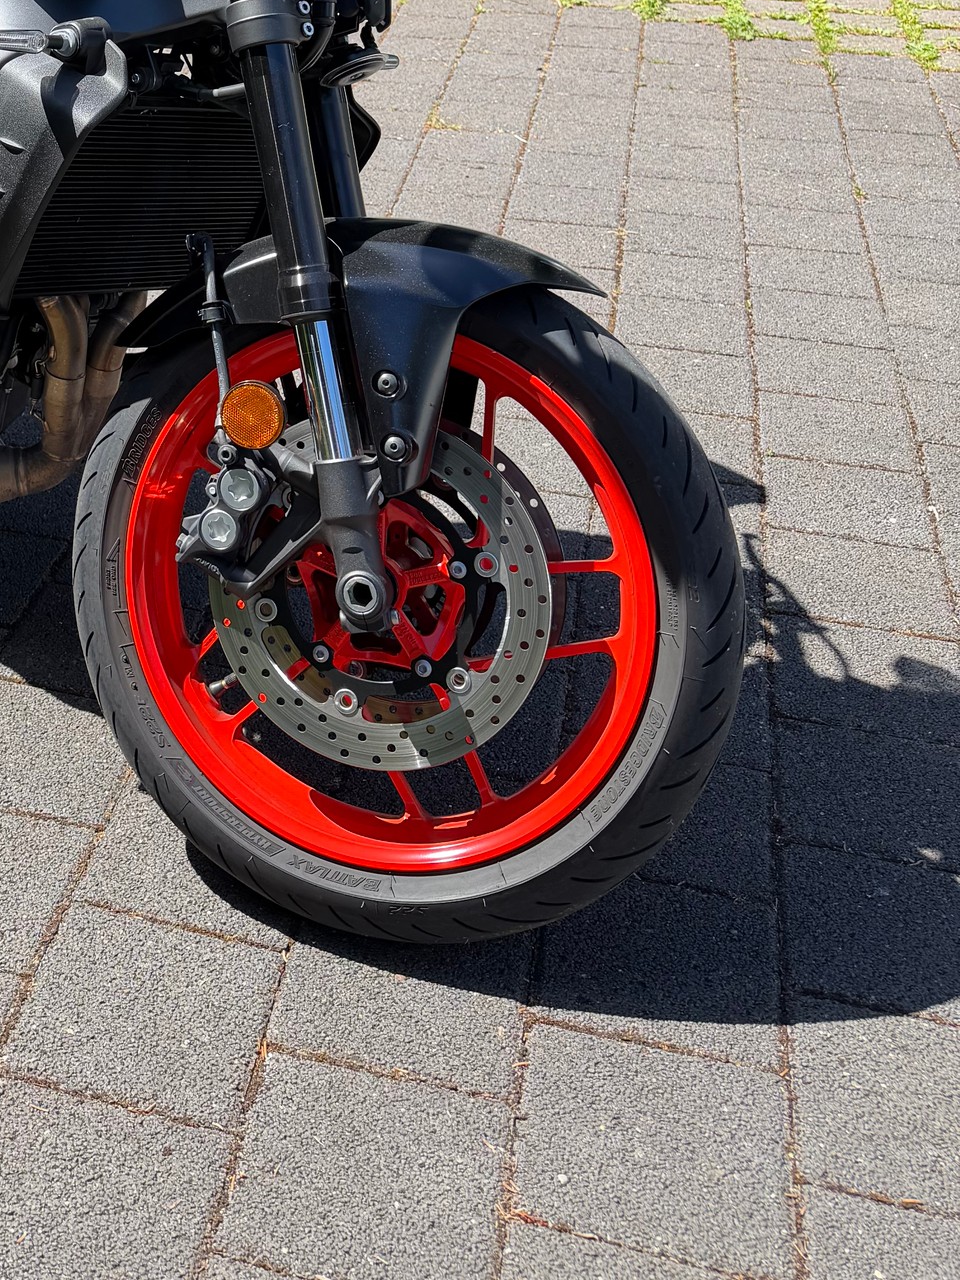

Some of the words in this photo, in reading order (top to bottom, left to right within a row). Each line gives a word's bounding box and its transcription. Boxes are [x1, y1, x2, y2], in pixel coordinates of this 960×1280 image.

[587, 707, 666, 823] BRIDGESTONE
[193, 782, 271, 852] HYPERSPORT
[286, 854, 382, 893] BATTLAX
